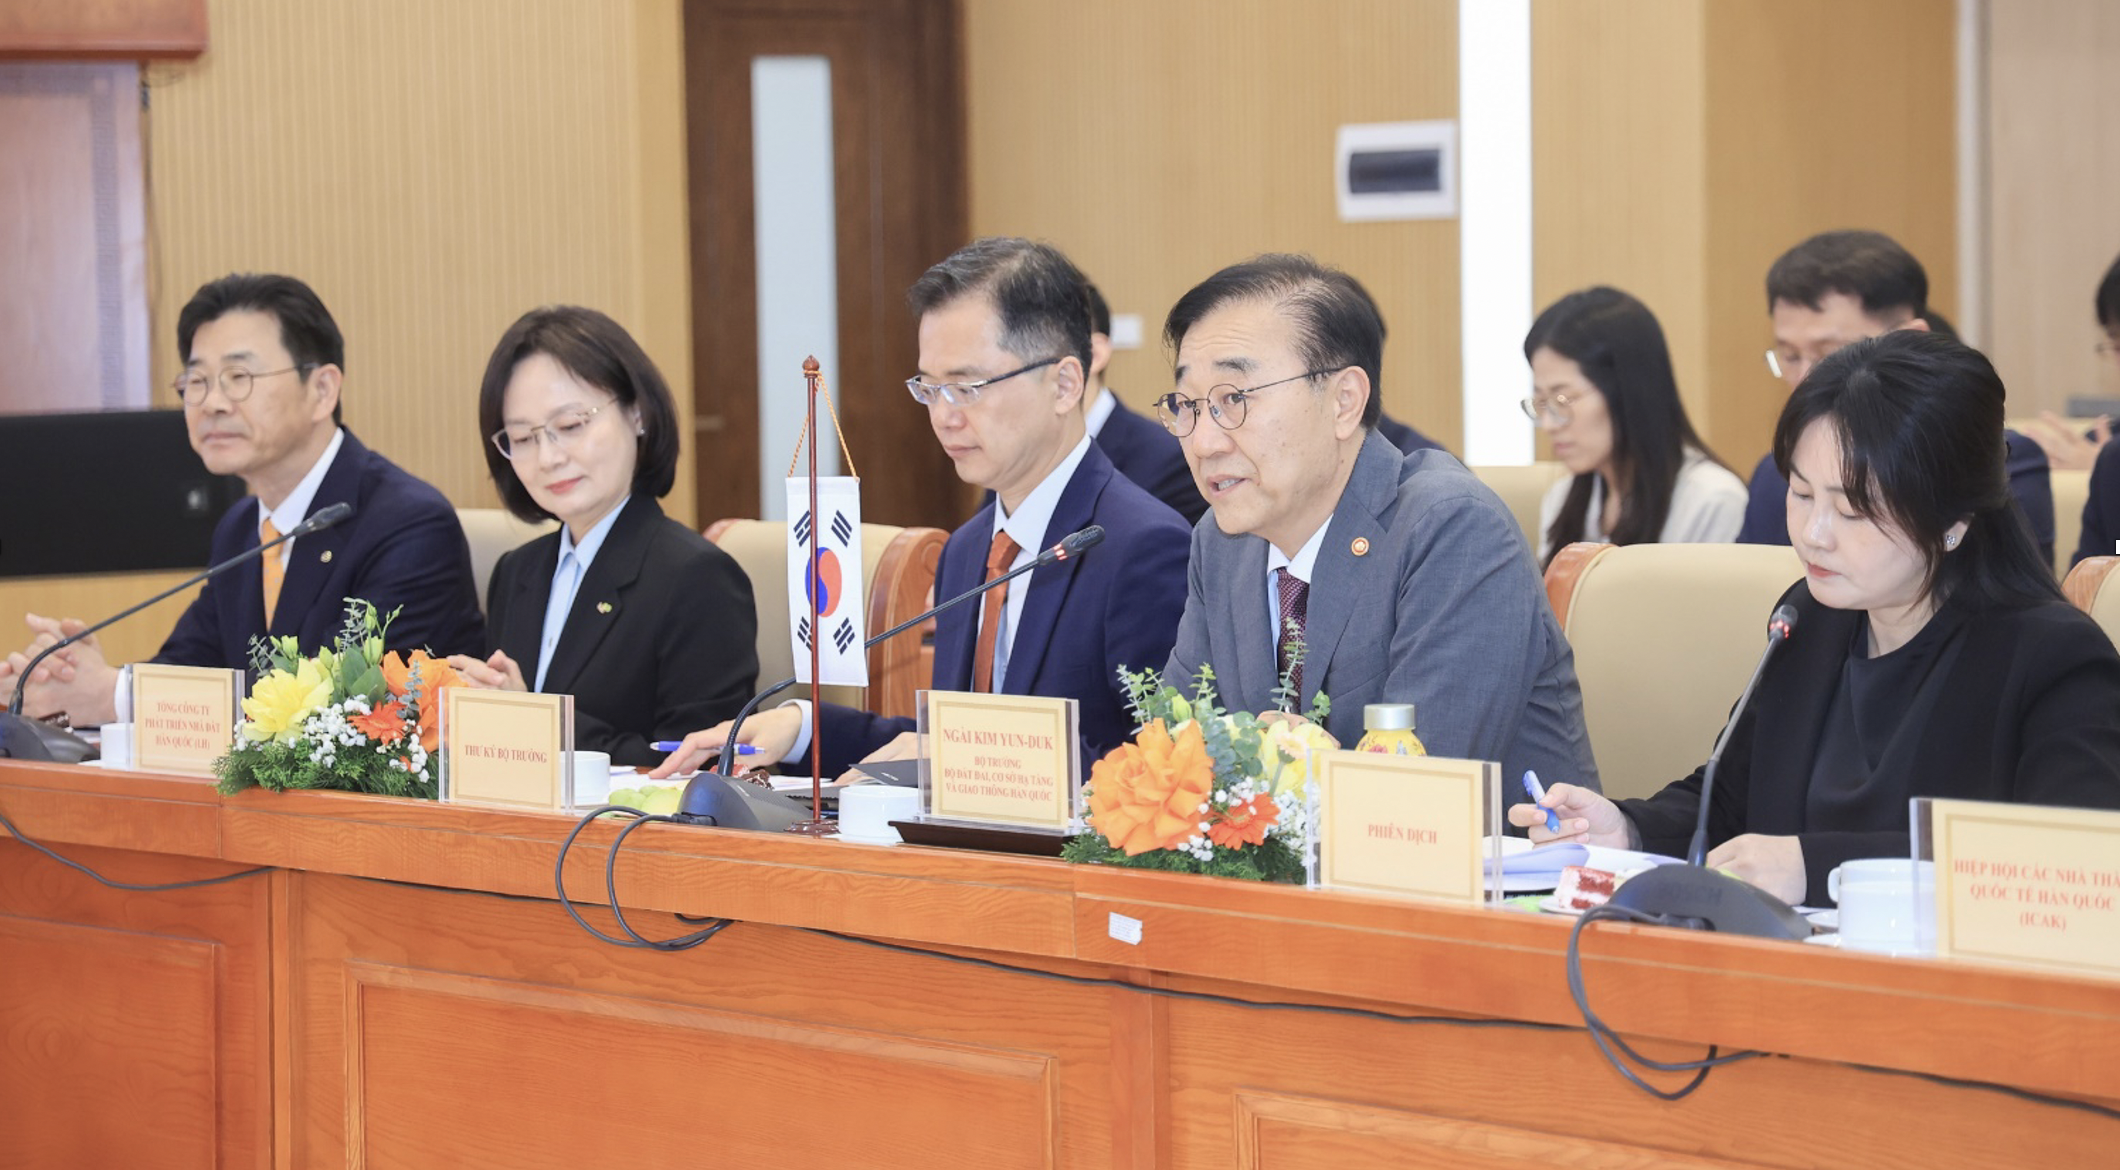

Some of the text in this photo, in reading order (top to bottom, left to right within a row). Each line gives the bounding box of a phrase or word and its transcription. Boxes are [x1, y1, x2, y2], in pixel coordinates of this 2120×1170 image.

[974, 731, 997, 746] KIM
[1000, 733, 1054, 750] YUN-DUK
[958, 784, 978, 795] GIAO
[1407, 827, 1437, 846] DỊCH
[2019, 911, 2067, 932] (ICAK)
